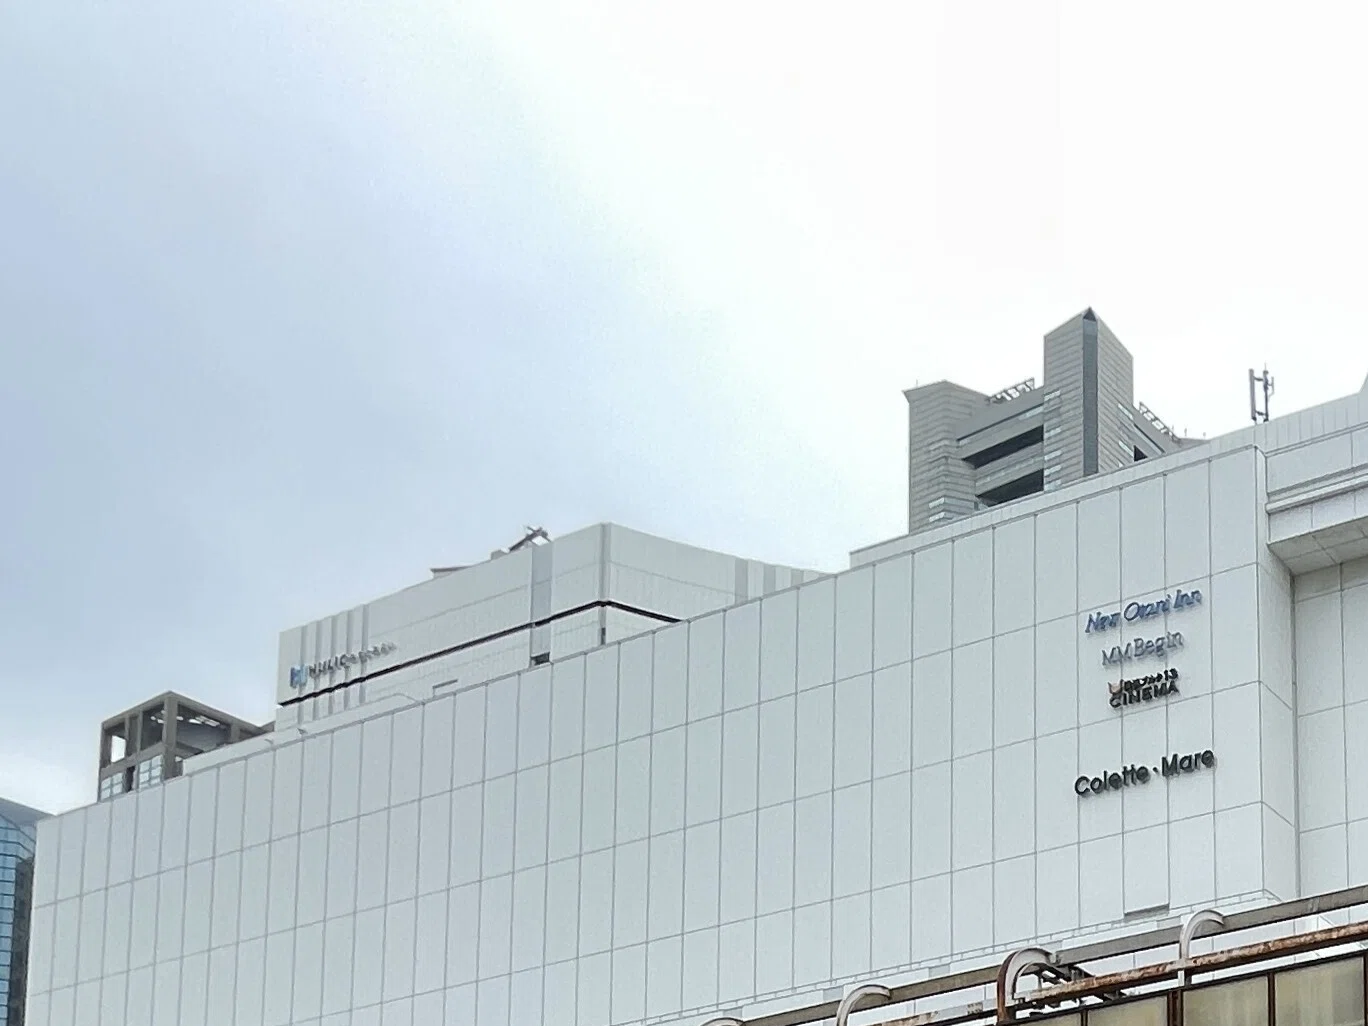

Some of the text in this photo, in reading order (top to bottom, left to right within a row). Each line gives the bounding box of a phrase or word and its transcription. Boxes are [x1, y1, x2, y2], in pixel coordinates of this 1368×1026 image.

[1085, 589, 1202, 633] New Otani Inn
[1133, 631, 1185, 658] Begin
[1109, 680, 1180, 708] CINEMA
